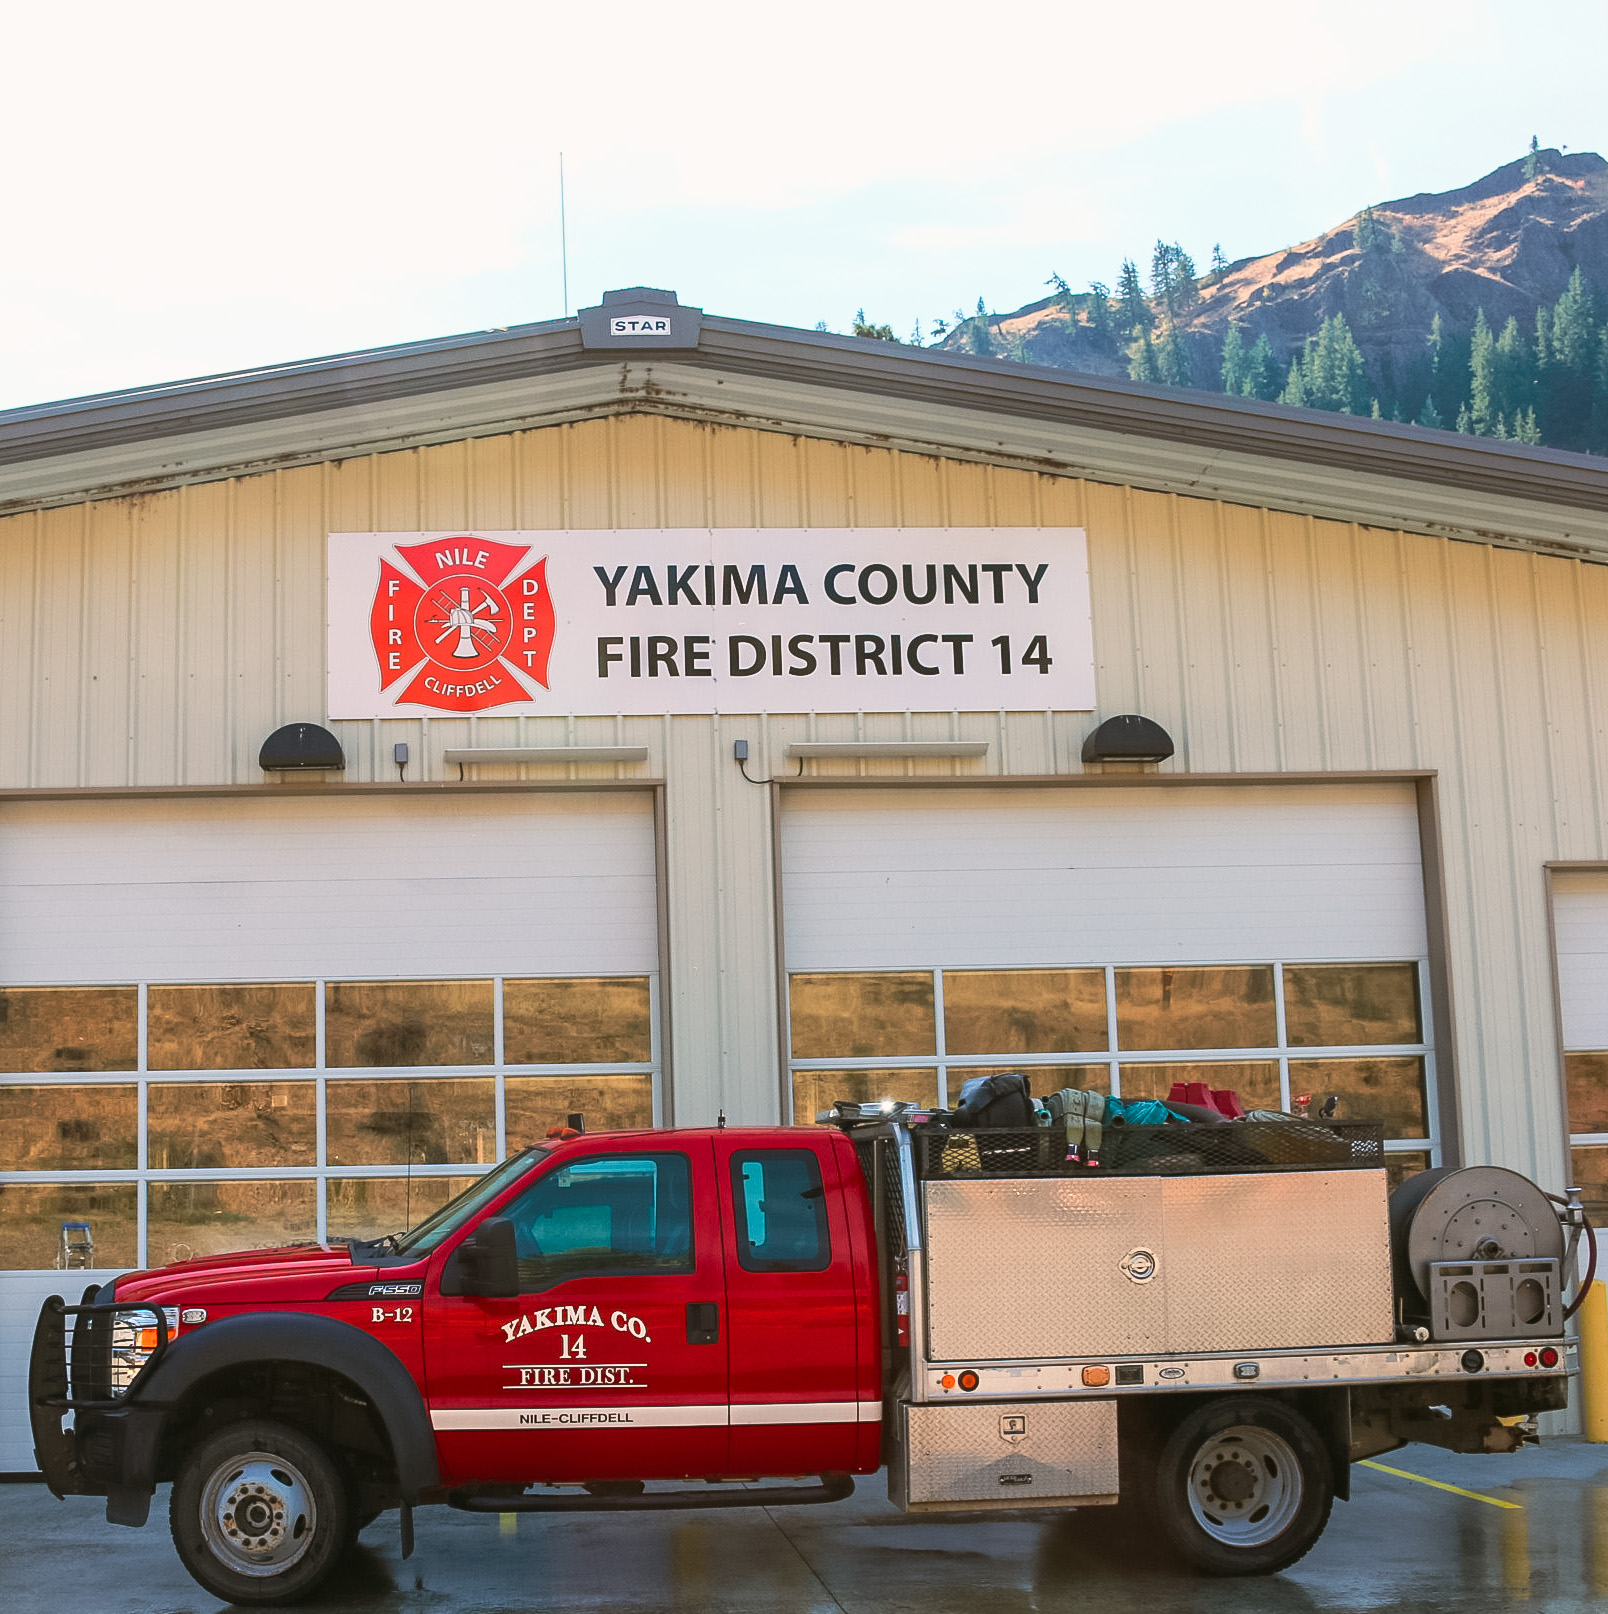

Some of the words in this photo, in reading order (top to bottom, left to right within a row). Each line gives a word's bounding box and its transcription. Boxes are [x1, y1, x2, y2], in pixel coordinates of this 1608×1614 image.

[614, 321, 667, 332] STAR
[434, 548, 490, 569] NILE
[593, 564, 810, 607] YAKIMA
[823, 563, 1050, 606] COUNTY
[387, 580, 403, 670] FIRE
[522, 579, 540, 667] DEPT
[597, 635, 712, 678] FIRE
[728, 634, 974, 677] DISTRICT
[990, 634, 1053, 675] 14
[424, 674, 502, 698] CLIFFDELL
[371, 1306, 413, 1323] B-12
[501, 1305, 605, 1343] YAKIMA
[559, 1333, 587, 1359] 14
[519, 1368, 571, 1386] FIRE
[580, 1367, 634, 1385] DIST.
[519, 1412, 634, 1425] NILE-CLIFFDELL
